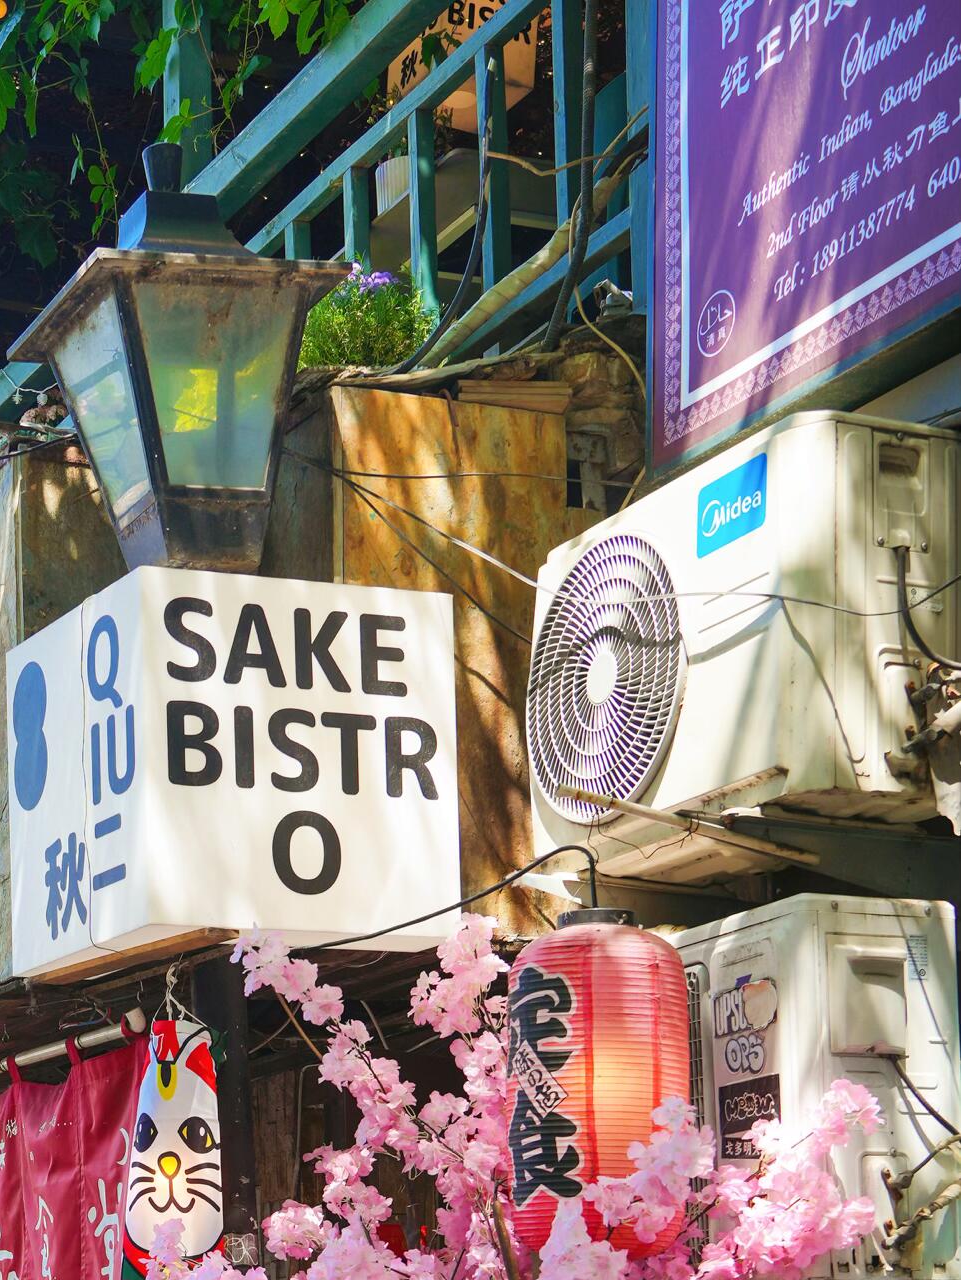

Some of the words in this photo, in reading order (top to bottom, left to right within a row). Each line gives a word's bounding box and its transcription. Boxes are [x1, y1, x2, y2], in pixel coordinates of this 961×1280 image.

[840, 4, 927, 101] Santoor
[738, 151, 810, 227] Authentic
[819, 110, 872, 163] Indian,
[767, 213, 797, 258] 2nd
[798, 190, 838, 235] Floor
[811, 184, 916, 279] 18911387774
[927, 156, 961, 198] 640
[701, 490, 762, 538] Midea
[163, 596, 409, 697] SAKE
[166, 699, 439, 801] BISTR
[271, 810, 342, 896] O
[725, 1034, 765, 1075] OPS
